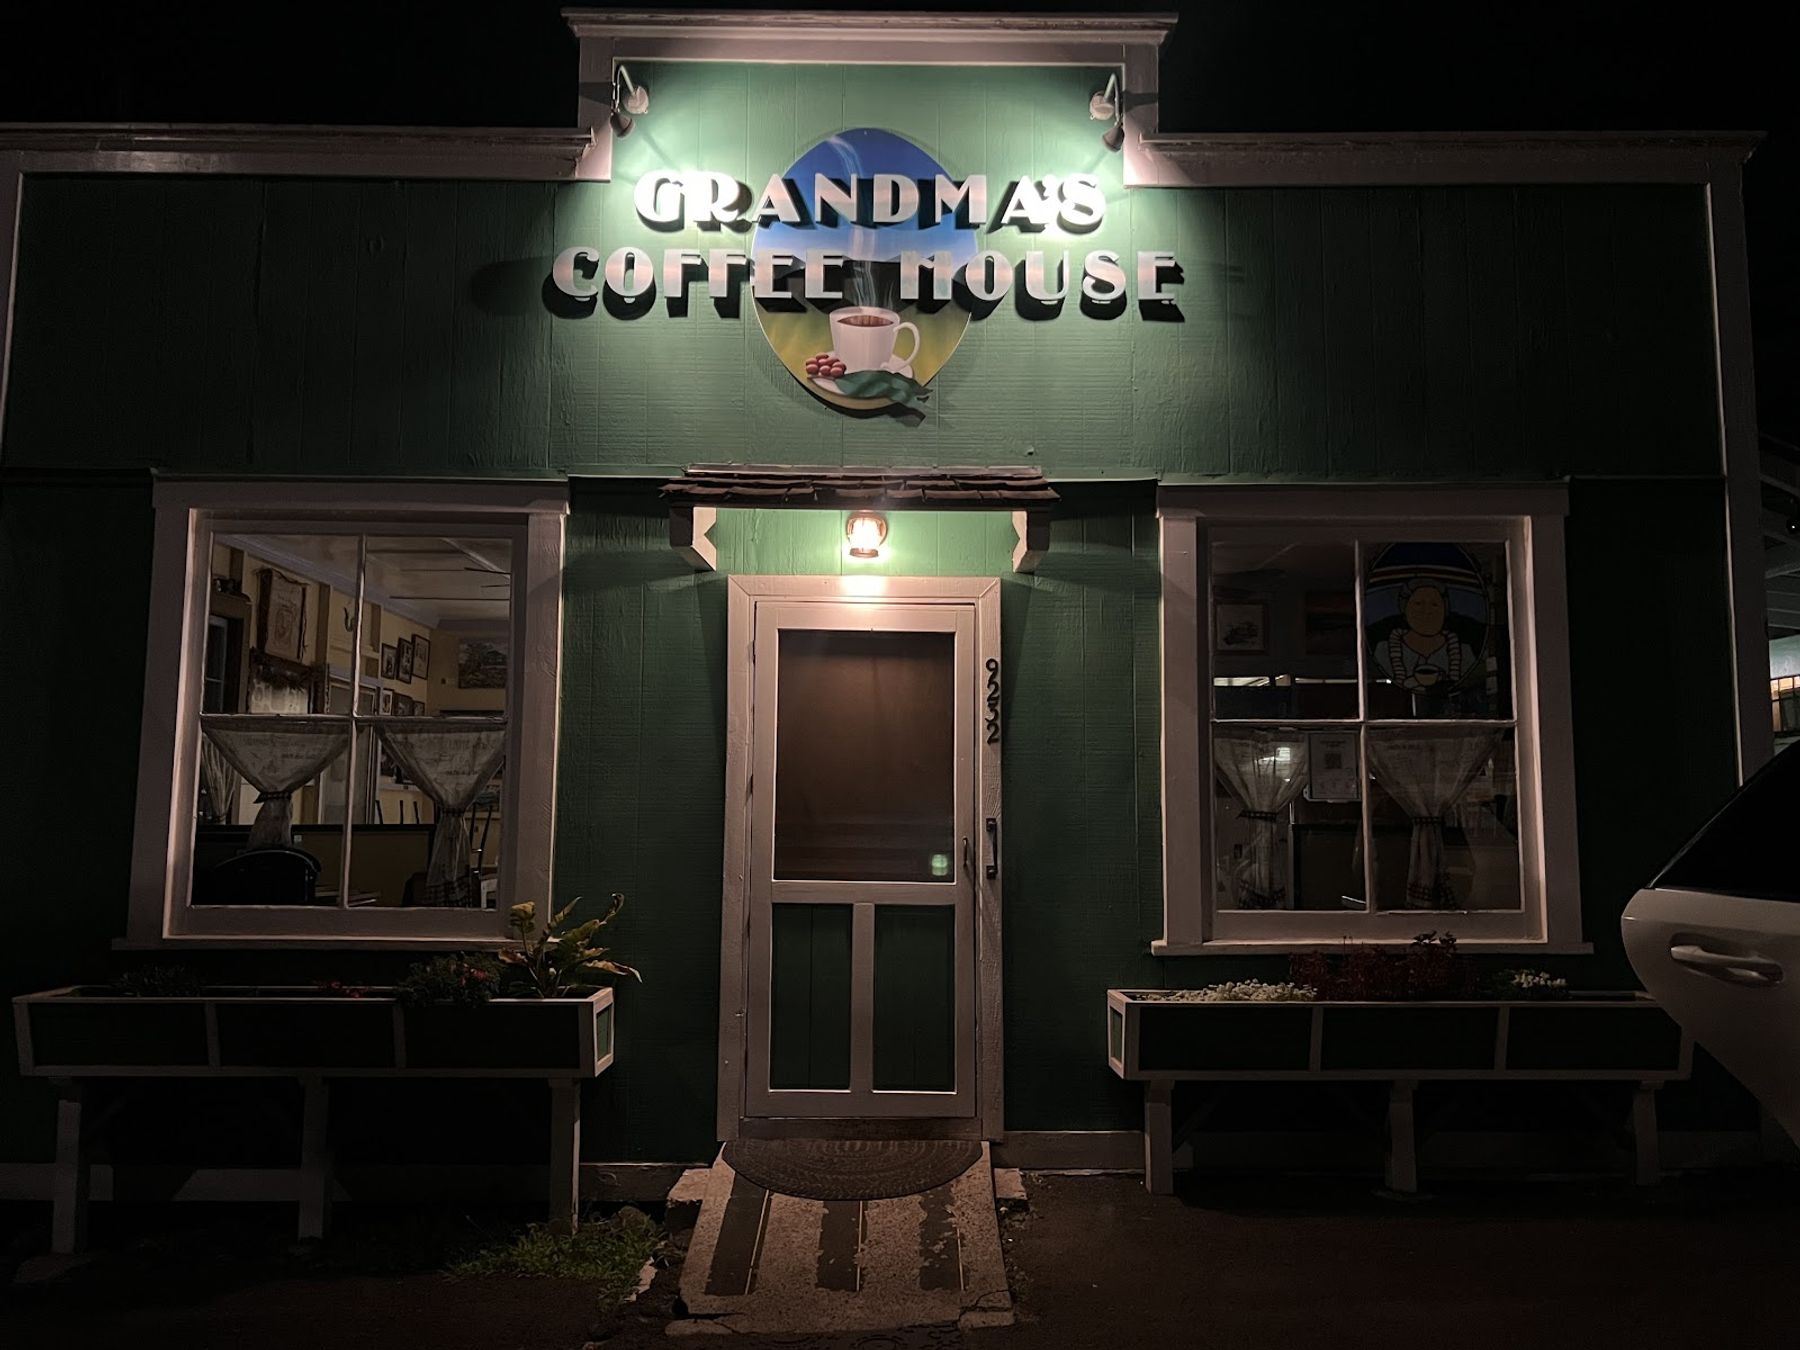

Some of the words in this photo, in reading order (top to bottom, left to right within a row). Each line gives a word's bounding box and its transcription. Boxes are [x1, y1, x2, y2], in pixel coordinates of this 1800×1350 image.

[633, 169, 1106, 227] GRANDMA'S
[551, 246, 844, 302] COFFEE
[900, 249, 1178, 303] HOUSE
[984, 657, 1000, 746] 9232
